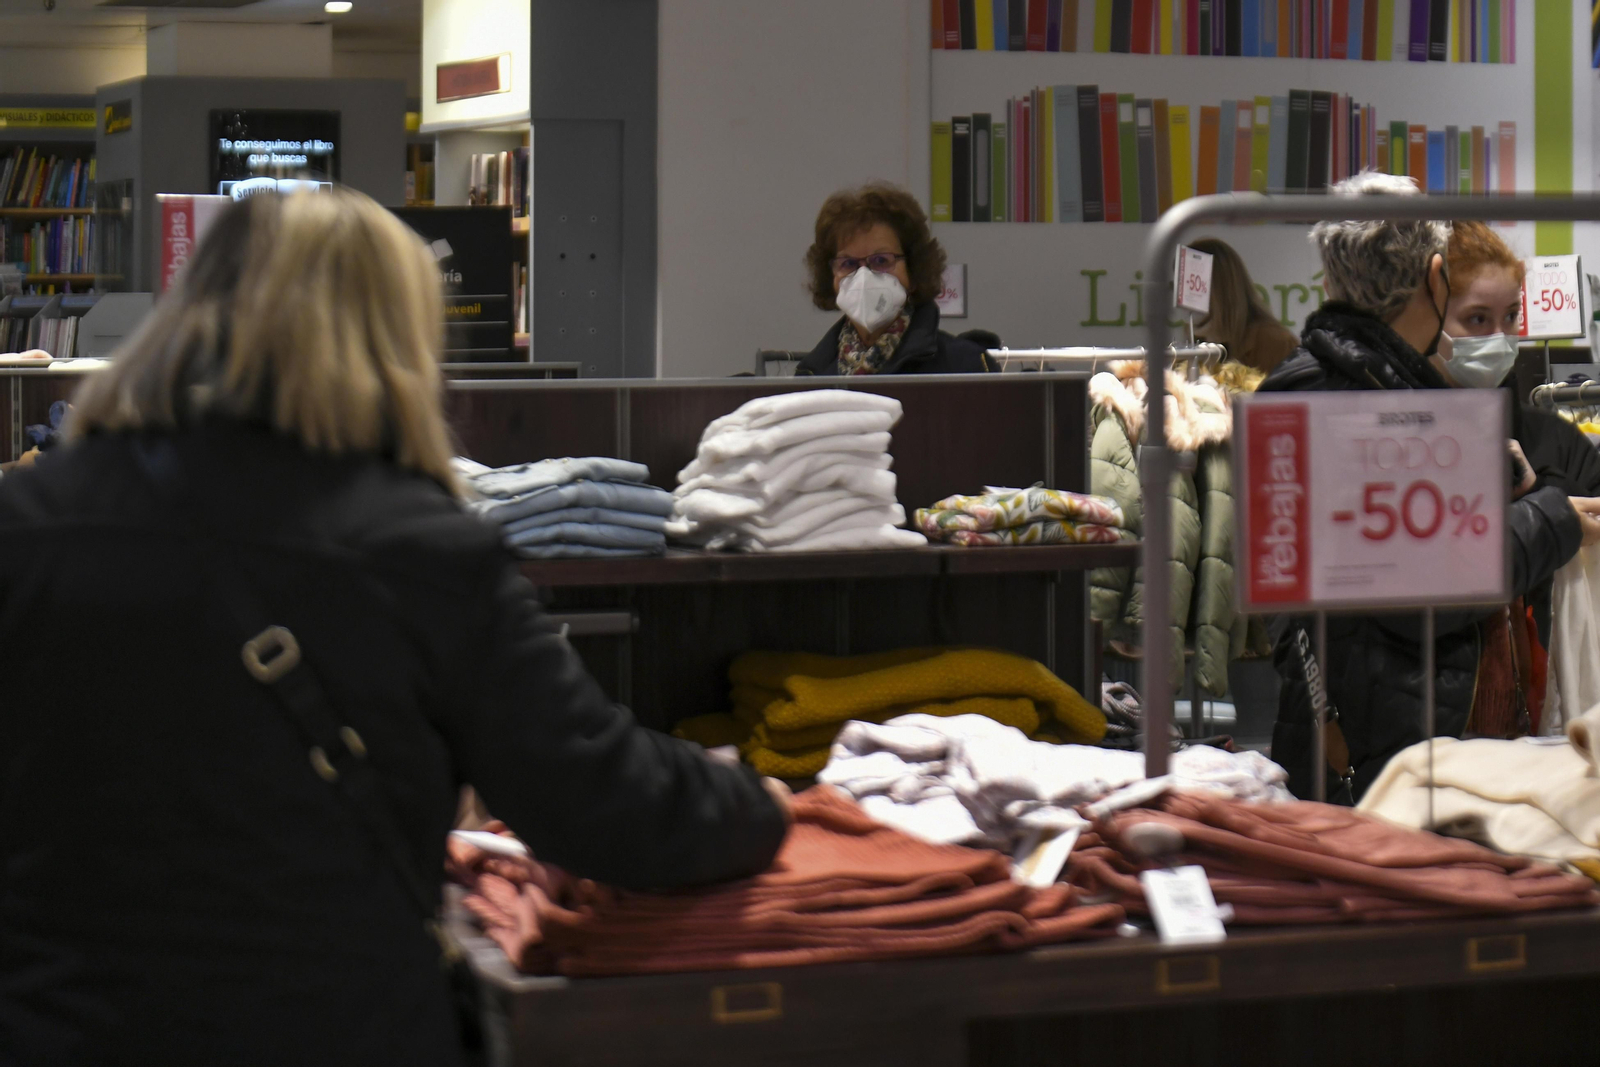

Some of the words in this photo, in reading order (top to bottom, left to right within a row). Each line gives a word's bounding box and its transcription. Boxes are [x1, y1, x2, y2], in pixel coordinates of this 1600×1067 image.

[220, 138, 232, 149] Te
[234, 139, 302, 151] conseguimos
[303, 140, 312, 150] el
[314, 140, 334, 150] libro
[248, 154, 270, 164] que
[271, 153, 307, 163] buscas
[1186, 273, 1209, 294] -50%
[1538, 271, 1568, 286] TODO
[1533, 288, 1577, 312] -50%
[1353, 435, 1463, 471] TODO
[1262, 432, 1304, 586] rebajas
[1331, 479, 1490, 541] -50%
